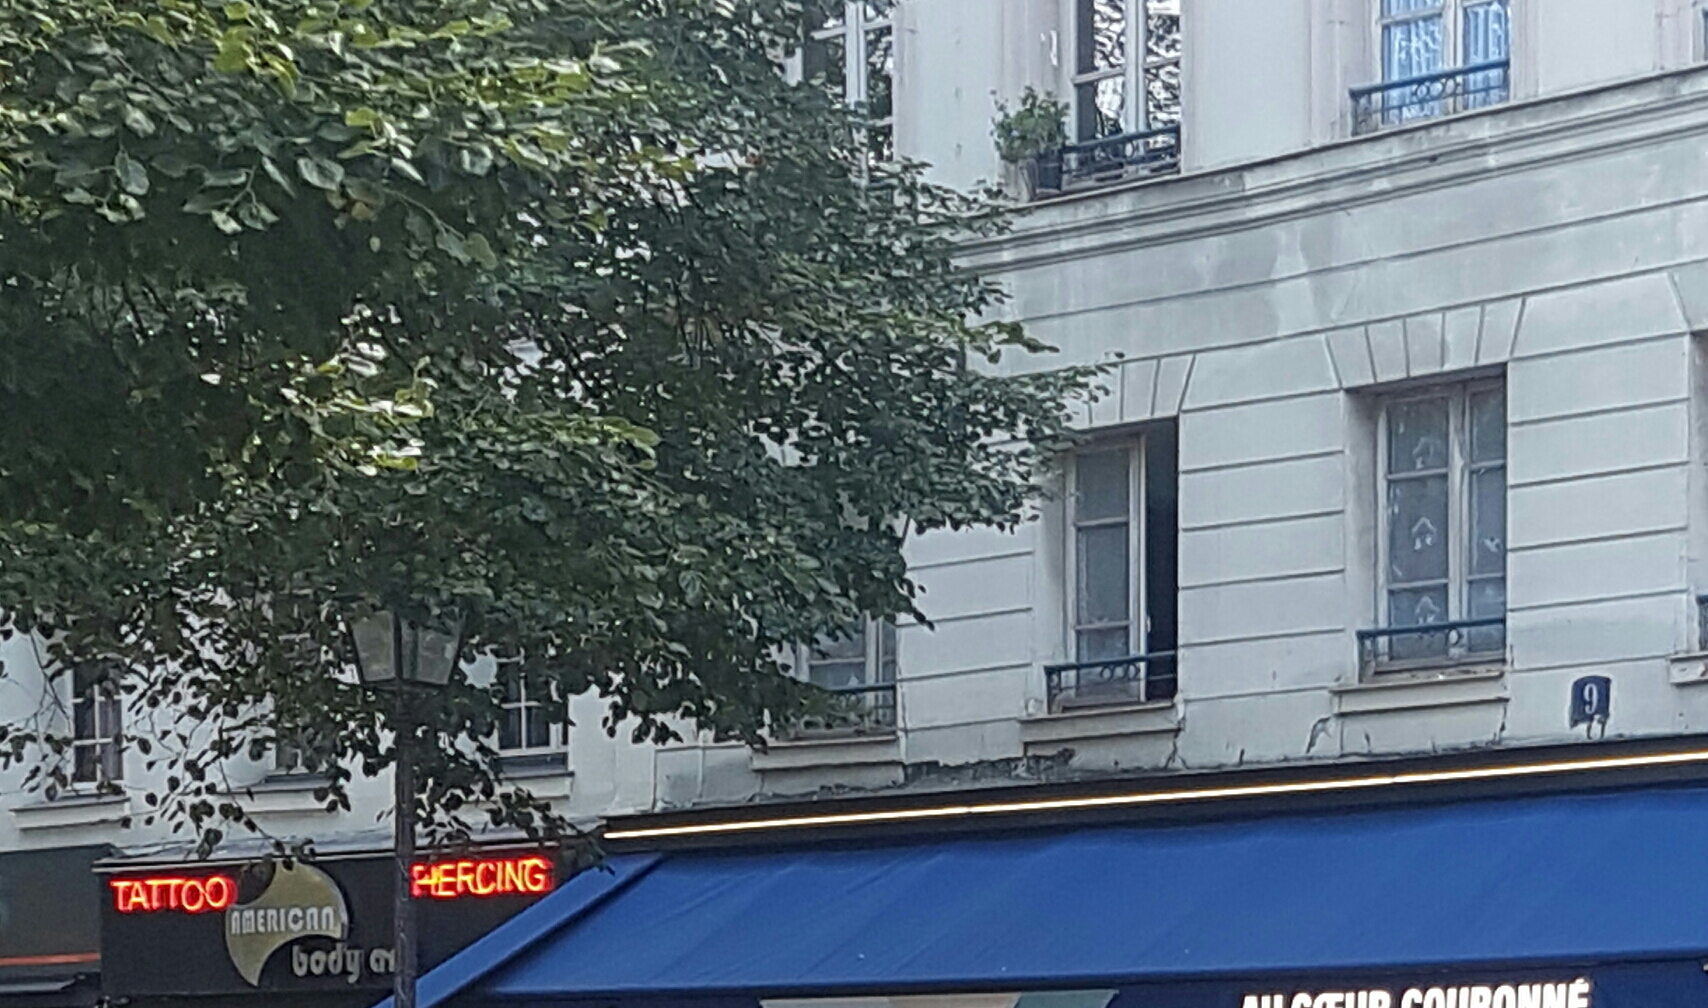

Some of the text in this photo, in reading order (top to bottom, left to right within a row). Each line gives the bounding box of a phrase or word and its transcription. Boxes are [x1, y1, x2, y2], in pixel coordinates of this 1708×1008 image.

[1582, 682, 1599, 715] 9
[110, 875, 232, 913] TATTOO
[410, 856, 552, 897] PIERCING
[292, 943, 363, 984] body
